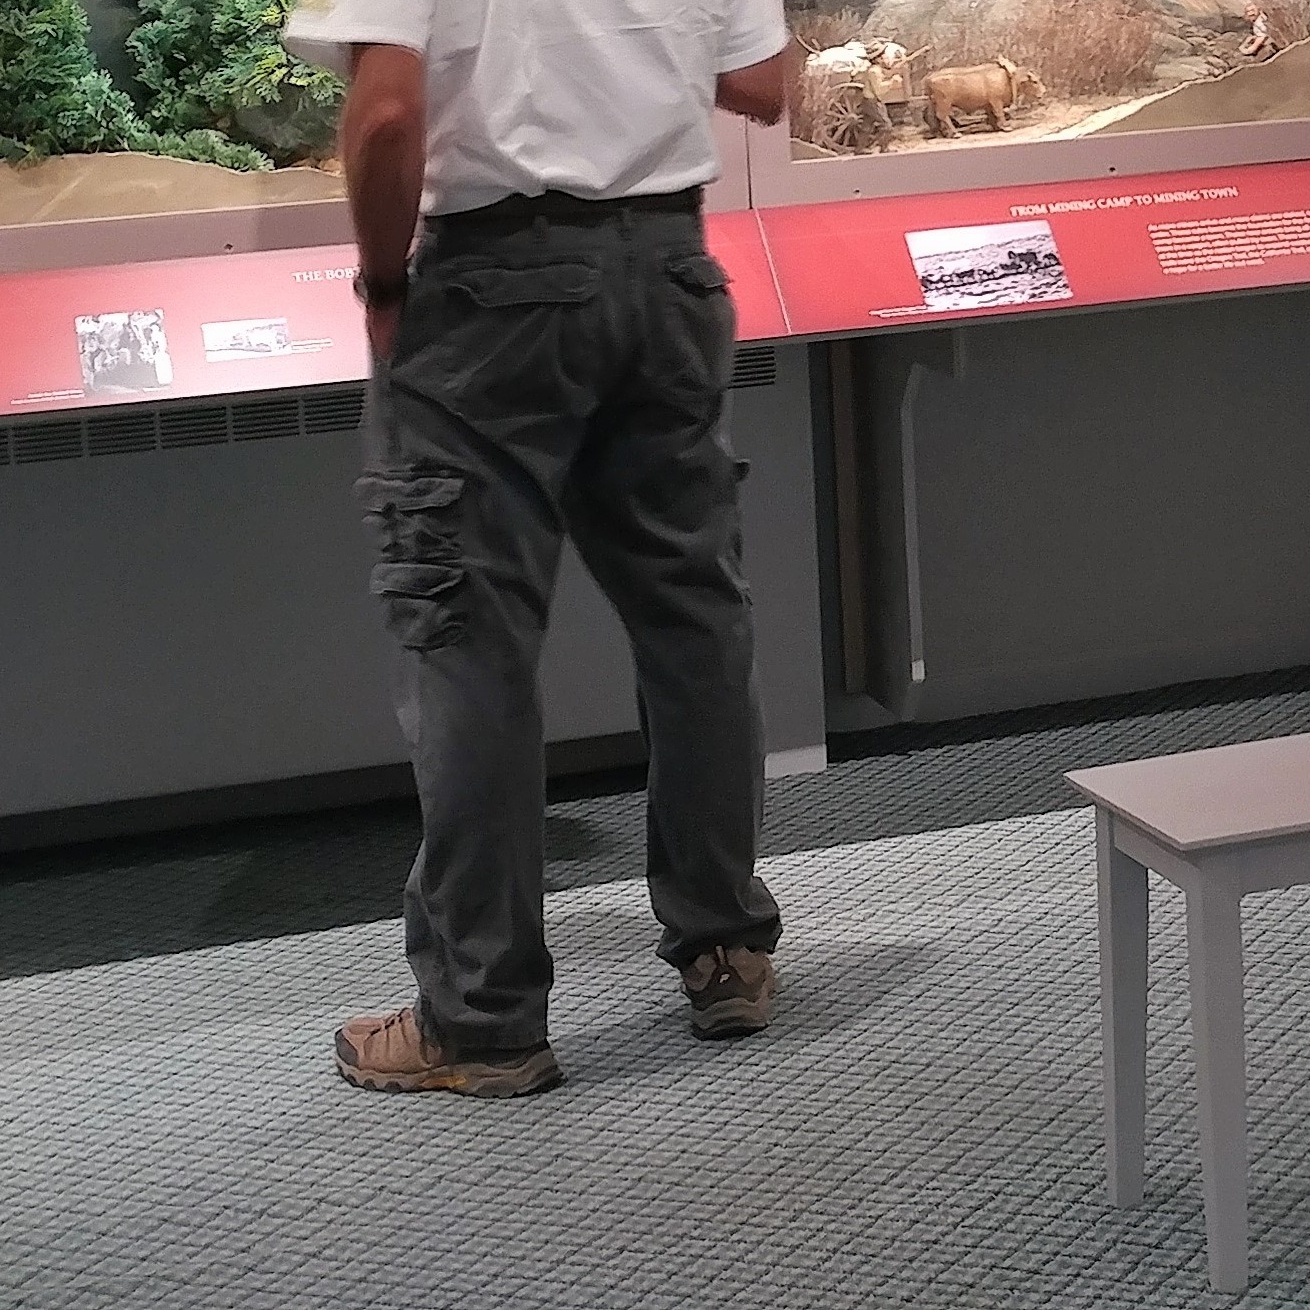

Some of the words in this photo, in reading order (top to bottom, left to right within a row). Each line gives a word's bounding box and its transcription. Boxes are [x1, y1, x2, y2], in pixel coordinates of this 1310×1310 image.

[1009, 205, 1048, 217] FROM
[1048, 199, 1098, 214] MINING
[1097, 195, 1134, 209] CAMP
[1134, 194, 1153, 206] TO
[1153, 189, 1200, 204] MINING
[1200, 186, 1239, 200] TOWN
[291, 270, 323, 283] THE
